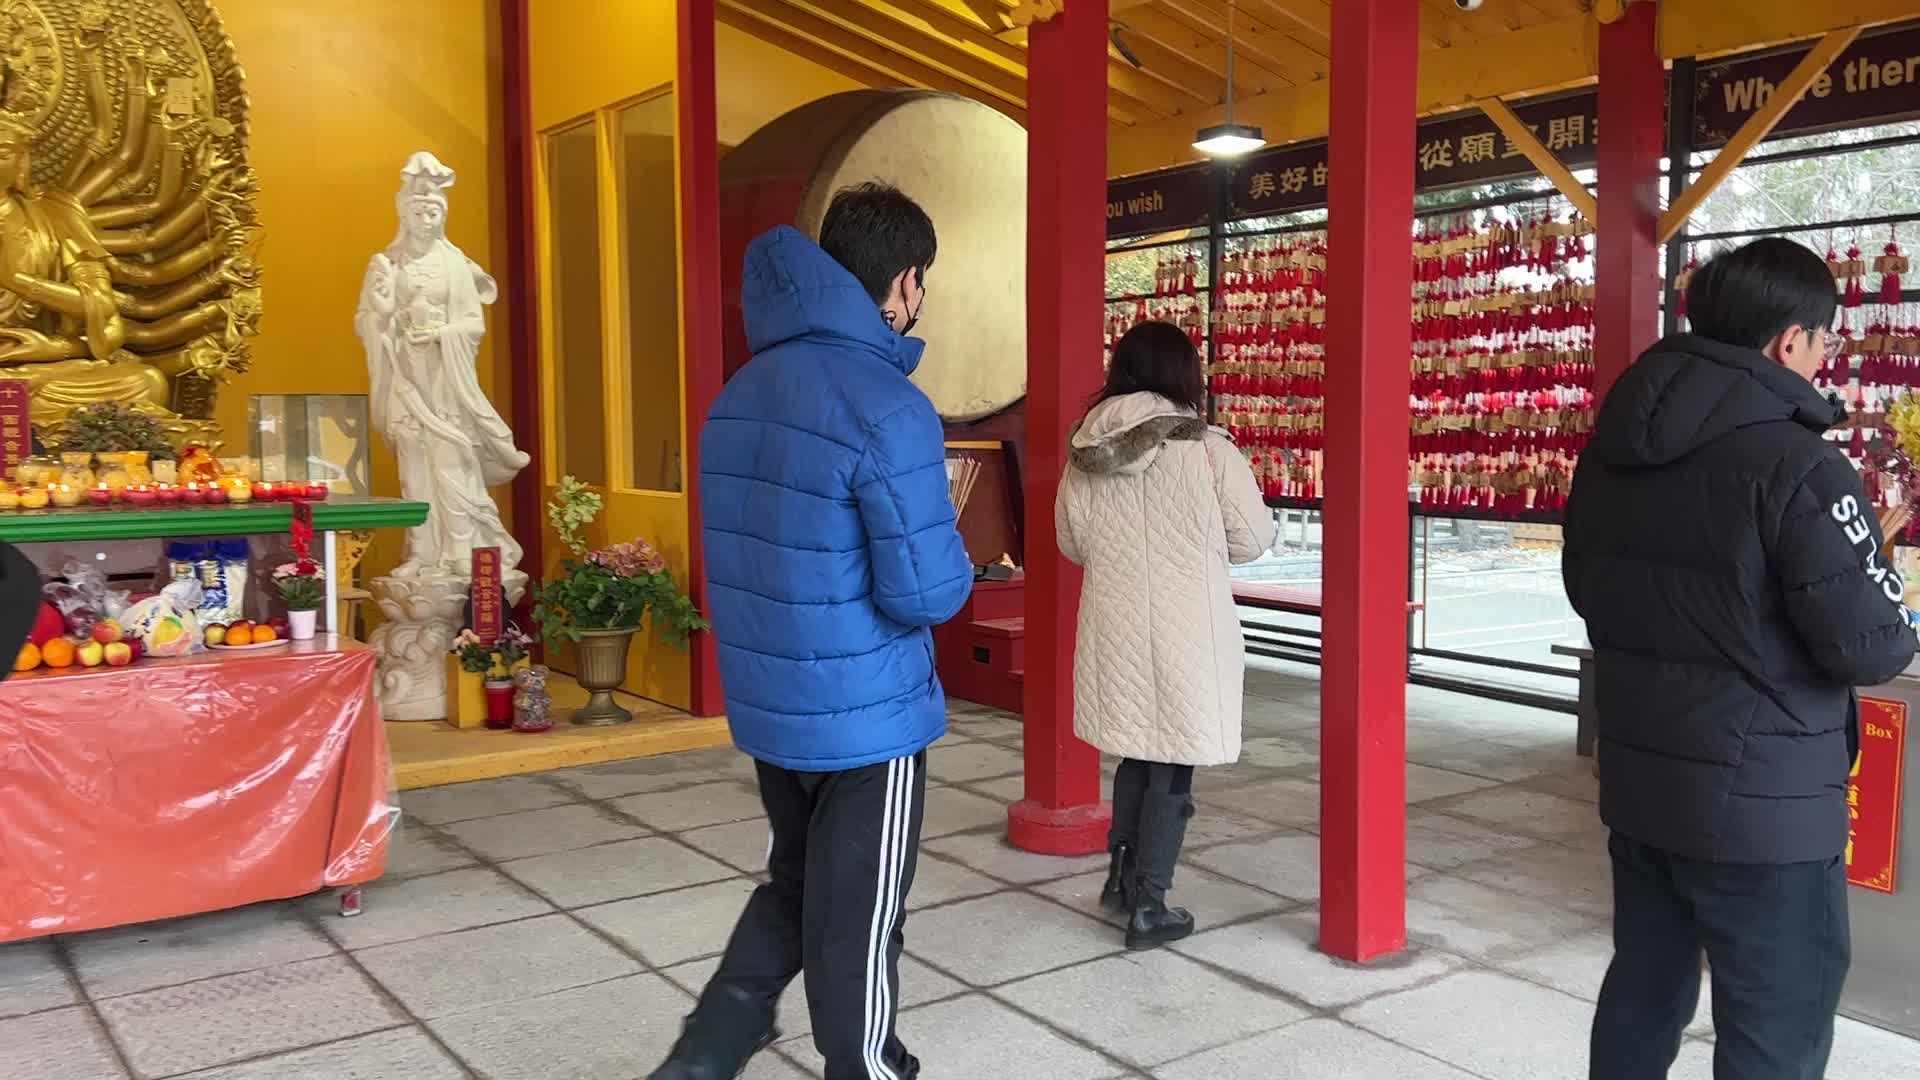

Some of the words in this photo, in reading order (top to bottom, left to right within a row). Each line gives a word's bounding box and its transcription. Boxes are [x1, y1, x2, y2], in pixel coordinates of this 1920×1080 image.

[1723, 73, 1832, 113] Whe
[1419, 115, 1599, 171] 從願開
[1106, 202, 1123, 218] ou
[1127, 190, 1163, 215] wish
[1865, 722, 1893, 740] Box
